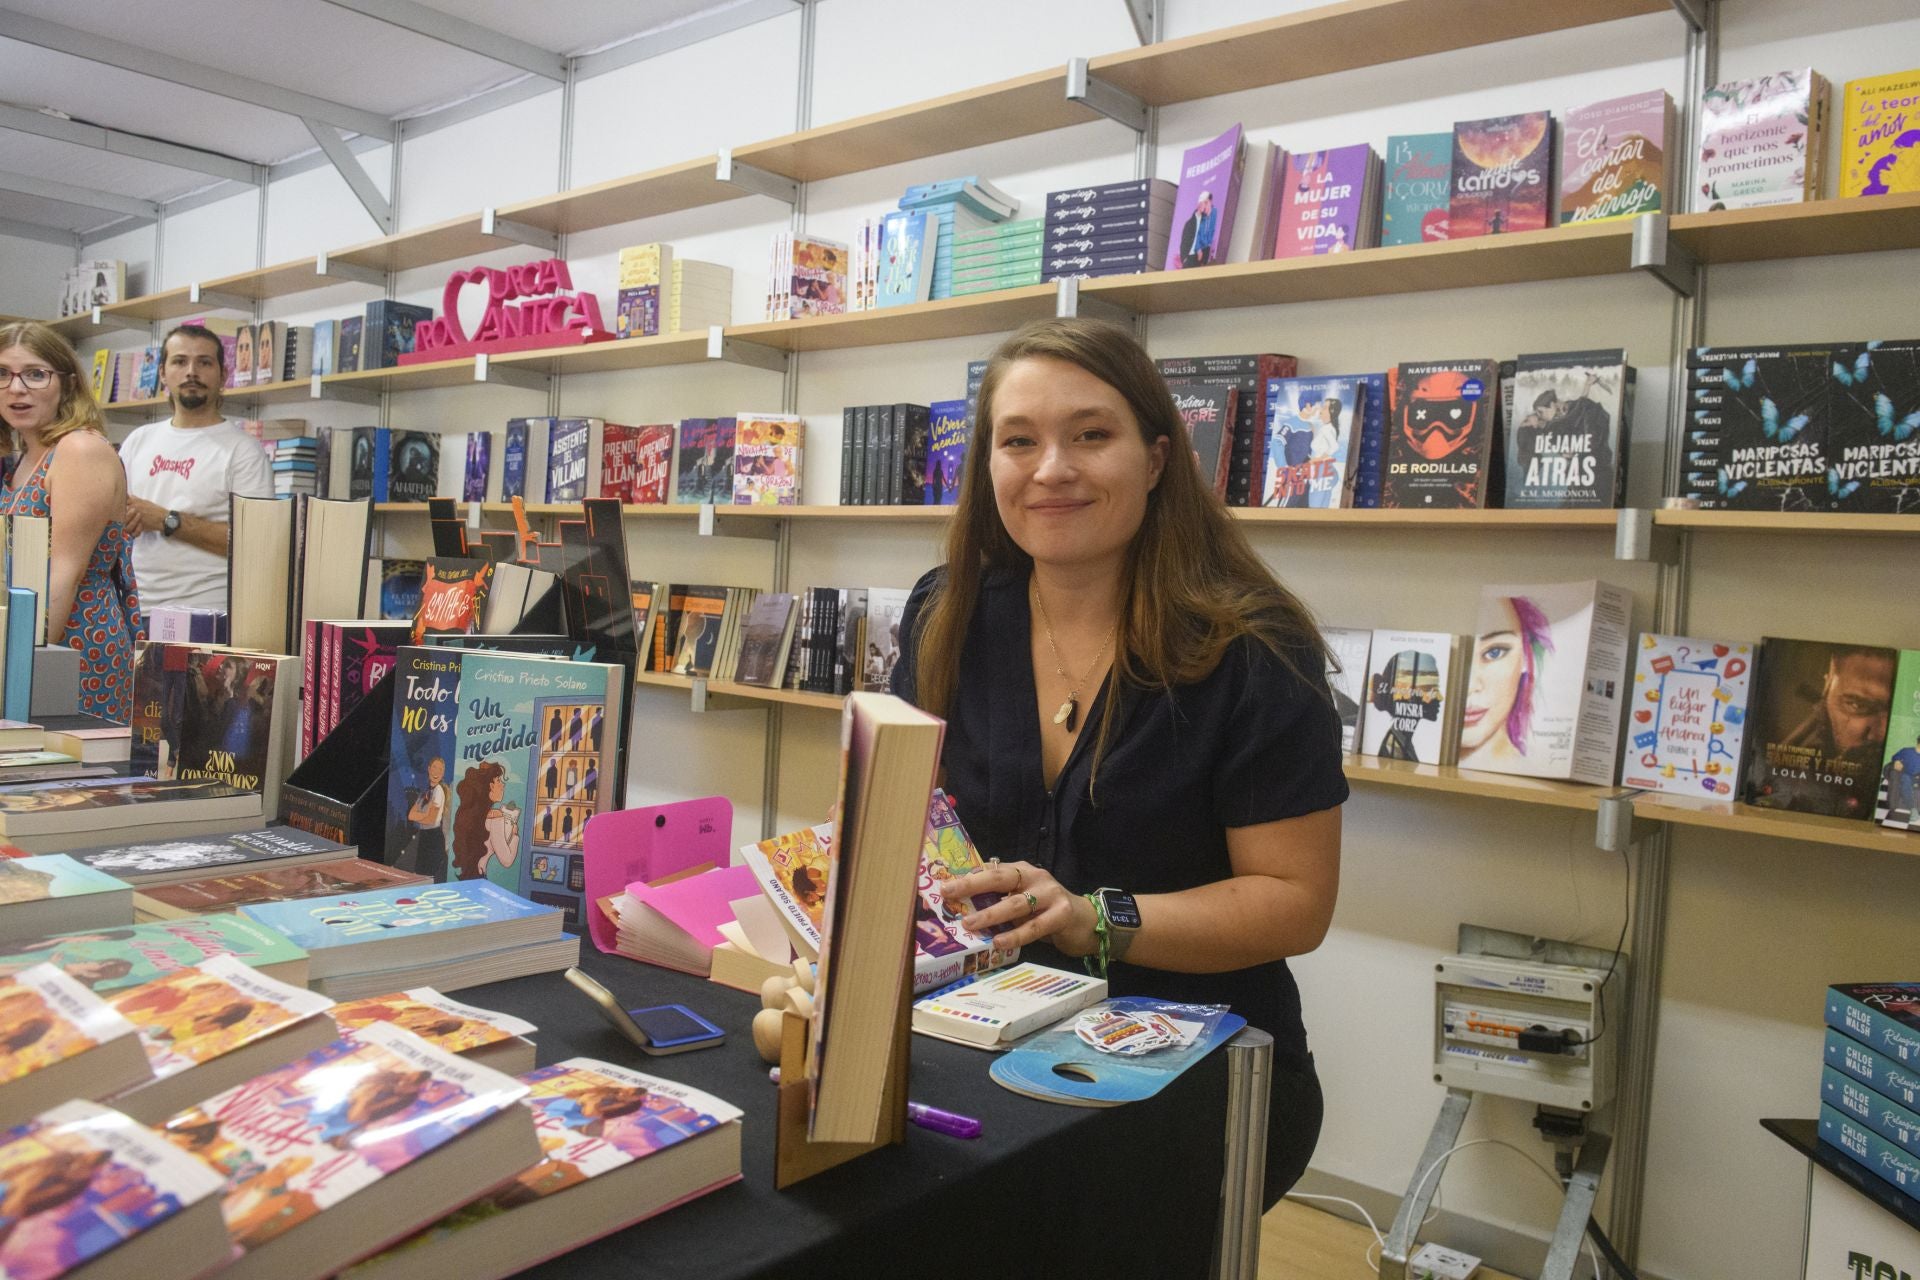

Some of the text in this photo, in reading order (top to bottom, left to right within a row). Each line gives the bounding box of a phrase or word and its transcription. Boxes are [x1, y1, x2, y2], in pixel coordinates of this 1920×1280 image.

[1861, 88, 1875, 96] ALI
[1720, 125, 1788, 144] horizonte
[1858, 112, 1908, 147] amor
[1577, 125, 1605, 158] El
[1724, 143, 1779, 160] que nos
[1581, 139, 1644, 176] cantar
[1707, 153, 1795, 178] prometimos
[1317, 171, 1333, 184] LA
[1592, 166, 1623, 194] del
[1294, 184, 1352, 206] MUJER
[1569, 181, 1657, 222] petirrojo
[1301, 206, 1338, 221] DE SU
[1297, 223, 1338, 240] VIDA
[1164, 366, 1196, 374] DESTINO
[552, 427, 588, 457] ASISTENTE
[639, 434, 671, 460] APRENDIZ
[1535, 432, 1593, 453] DÉJAME
[563, 451, 573, 465] DEL
[613, 455, 624, 467] DEL
[648, 455, 658, 468] DEL
[1732, 443, 1820, 463] MARIPOSAS
[551, 457, 586, 489] VILLANO
[636, 460, 668, 489] VILLANO
[1275, 458, 1337, 484] SKATE
[1390, 463, 1478, 474] DE RODILLAS
[1524, 453, 1597, 486] ATRÁS
[1725, 457, 1826, 480] VIOLENTAS
[1310, 476, 1335, 493] ME
[256, 662, 271, 671] HQN
[412, 658, 447, 672] Cristina
[406, 675, 452, 703] Todo
[475, 668, 588, 690] Cristina Prieto Solano
[1377, 682, 1388, 695] El
[1679, 687, 1700, 701] Un
[469, 696, 505, 721] Un
[1669, 698, 1707, 715] lugar
[430, 714, 453, 733] es
[467, 717, 511, 737] error a
[1671, 713, 1701, 726] para
[463, 724, 539, 762] medida
[1660, 726, 1706, 742] Andrea
[205, 750, 235, 772] ¿NOS
[1771, 767, 1854, 786] LOLA TORO
[1846, 1005, 1871, 1026] CHLOE
[1845, 1016, 1870, 1037] WALSH
[1846, 1047, 1873, 1068] CHLOE
[1898, 1045, 1908, 1060] 10
[1845, 1057, 1873, 1079] WALSH
[1842, 1096, 1869, 1117] WALSH
[1843, 1085, 1870, 1107] CHLOE
[1903, 1088, 1914, 1104] 10
[1842, 1123, 1868, 1147] CHLOE
[1898, 1128, 1908, 1144] 10
[1841, 1134, 1867, 1158] WALSH
[1895, 1169, 1906, 1185] 10
